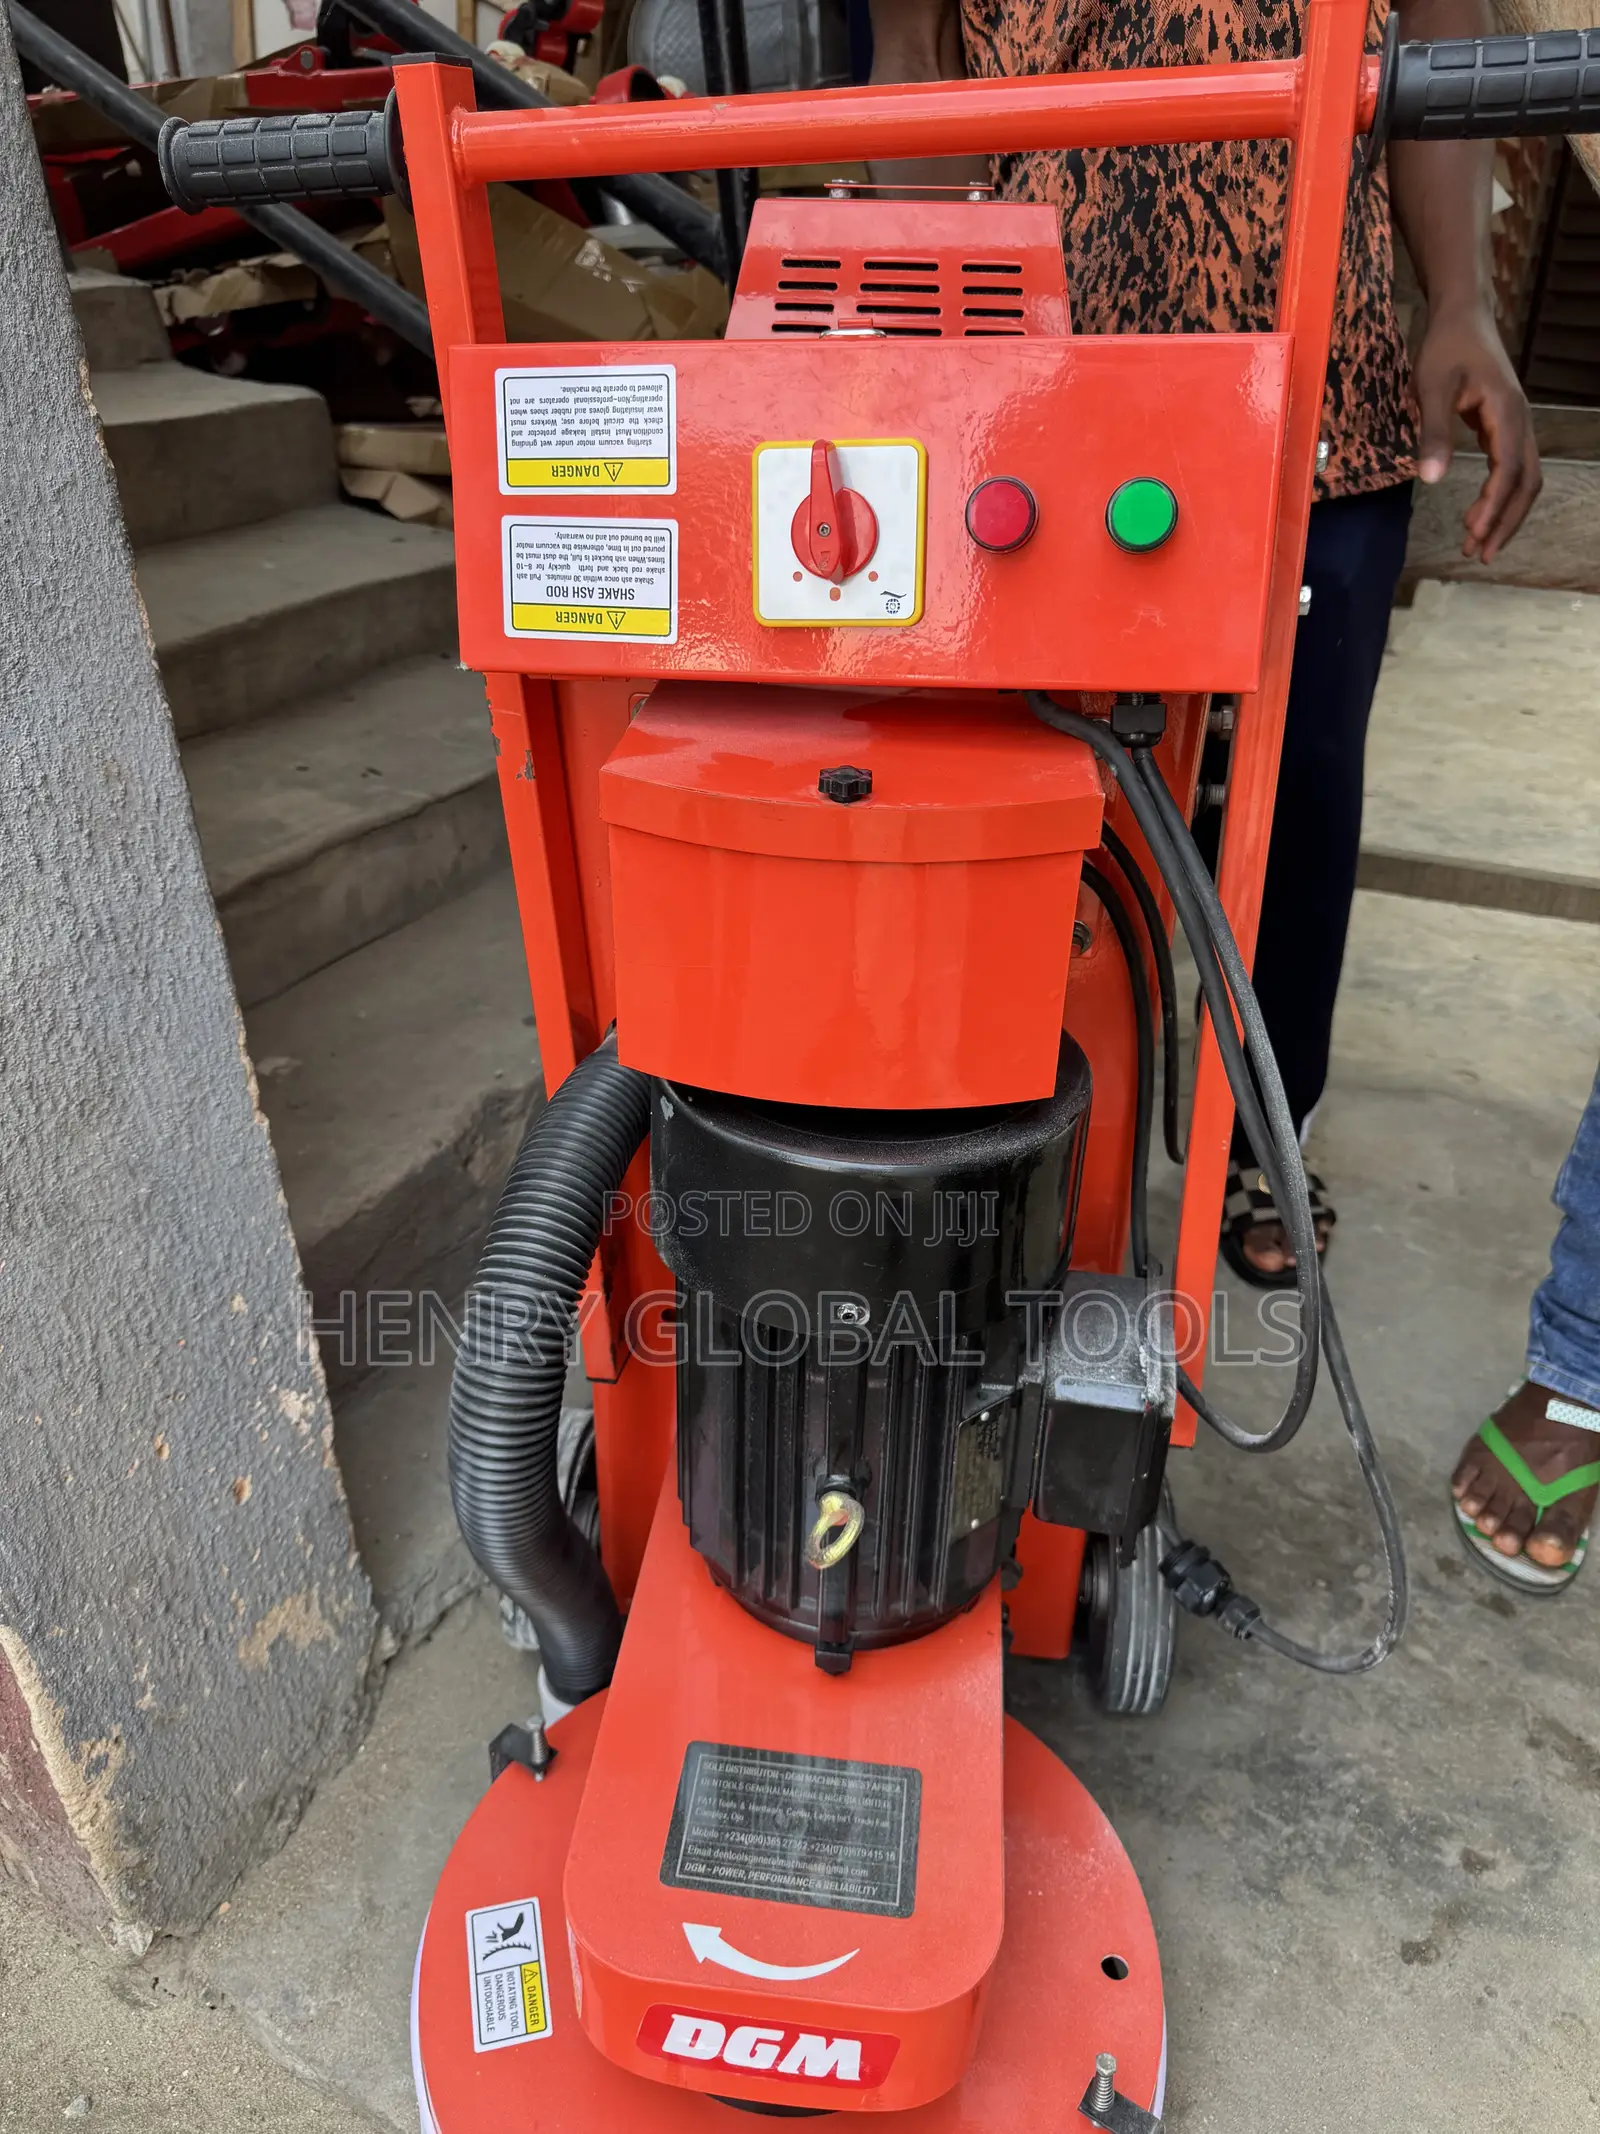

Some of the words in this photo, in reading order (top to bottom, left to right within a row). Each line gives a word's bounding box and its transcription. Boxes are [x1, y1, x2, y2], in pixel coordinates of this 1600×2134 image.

[602, 384, 626, 392] operate
[637, 384, 662, 392] allowed
[539, 396, 569, 404] operators
[589, 406, 609, 414] gloves
[612, 405, 643, 414] insulating
[527, 428, 556, 436] protector
[561, 428, 586, 436] leakage
[511, 439, 537, 447] grinding
[627, 437, 652, 446] starting
[551, 465, 599, 476] DANGER
[554, 531, 584, 540] warranty.
[605, 544, 621, 552] time,
[642, 544, 665, 553] poured
[547, 562, 570, 571] quickly
[546, 585, 568, 597] ROD
[572, 586, 594, 598] ASH
[598, 587, 634, 599] SHAKE
[555, 611, 602, 624] DANGER
[691, 1826, 719, 1837] Mobile
[684, 1861, 705, 1873] DGM
[711, 1865, 747, 1879] POWER,
[747, 1869, 815, 1888] PERFORMANCE
[823, 1879, 878, 1896] RELIABILITY
[506, 1970, 517, 2009] ROTATING
[494, 1973, 506, 2020] DANGEROUS
[483, 1975, 495, 2032] UNTOUCHABLE
[526, 1985, 540, 2026] DANGER
[509, 2010, 519, 2032] TOOL
[661, 2013, 863, 2081] DGM
